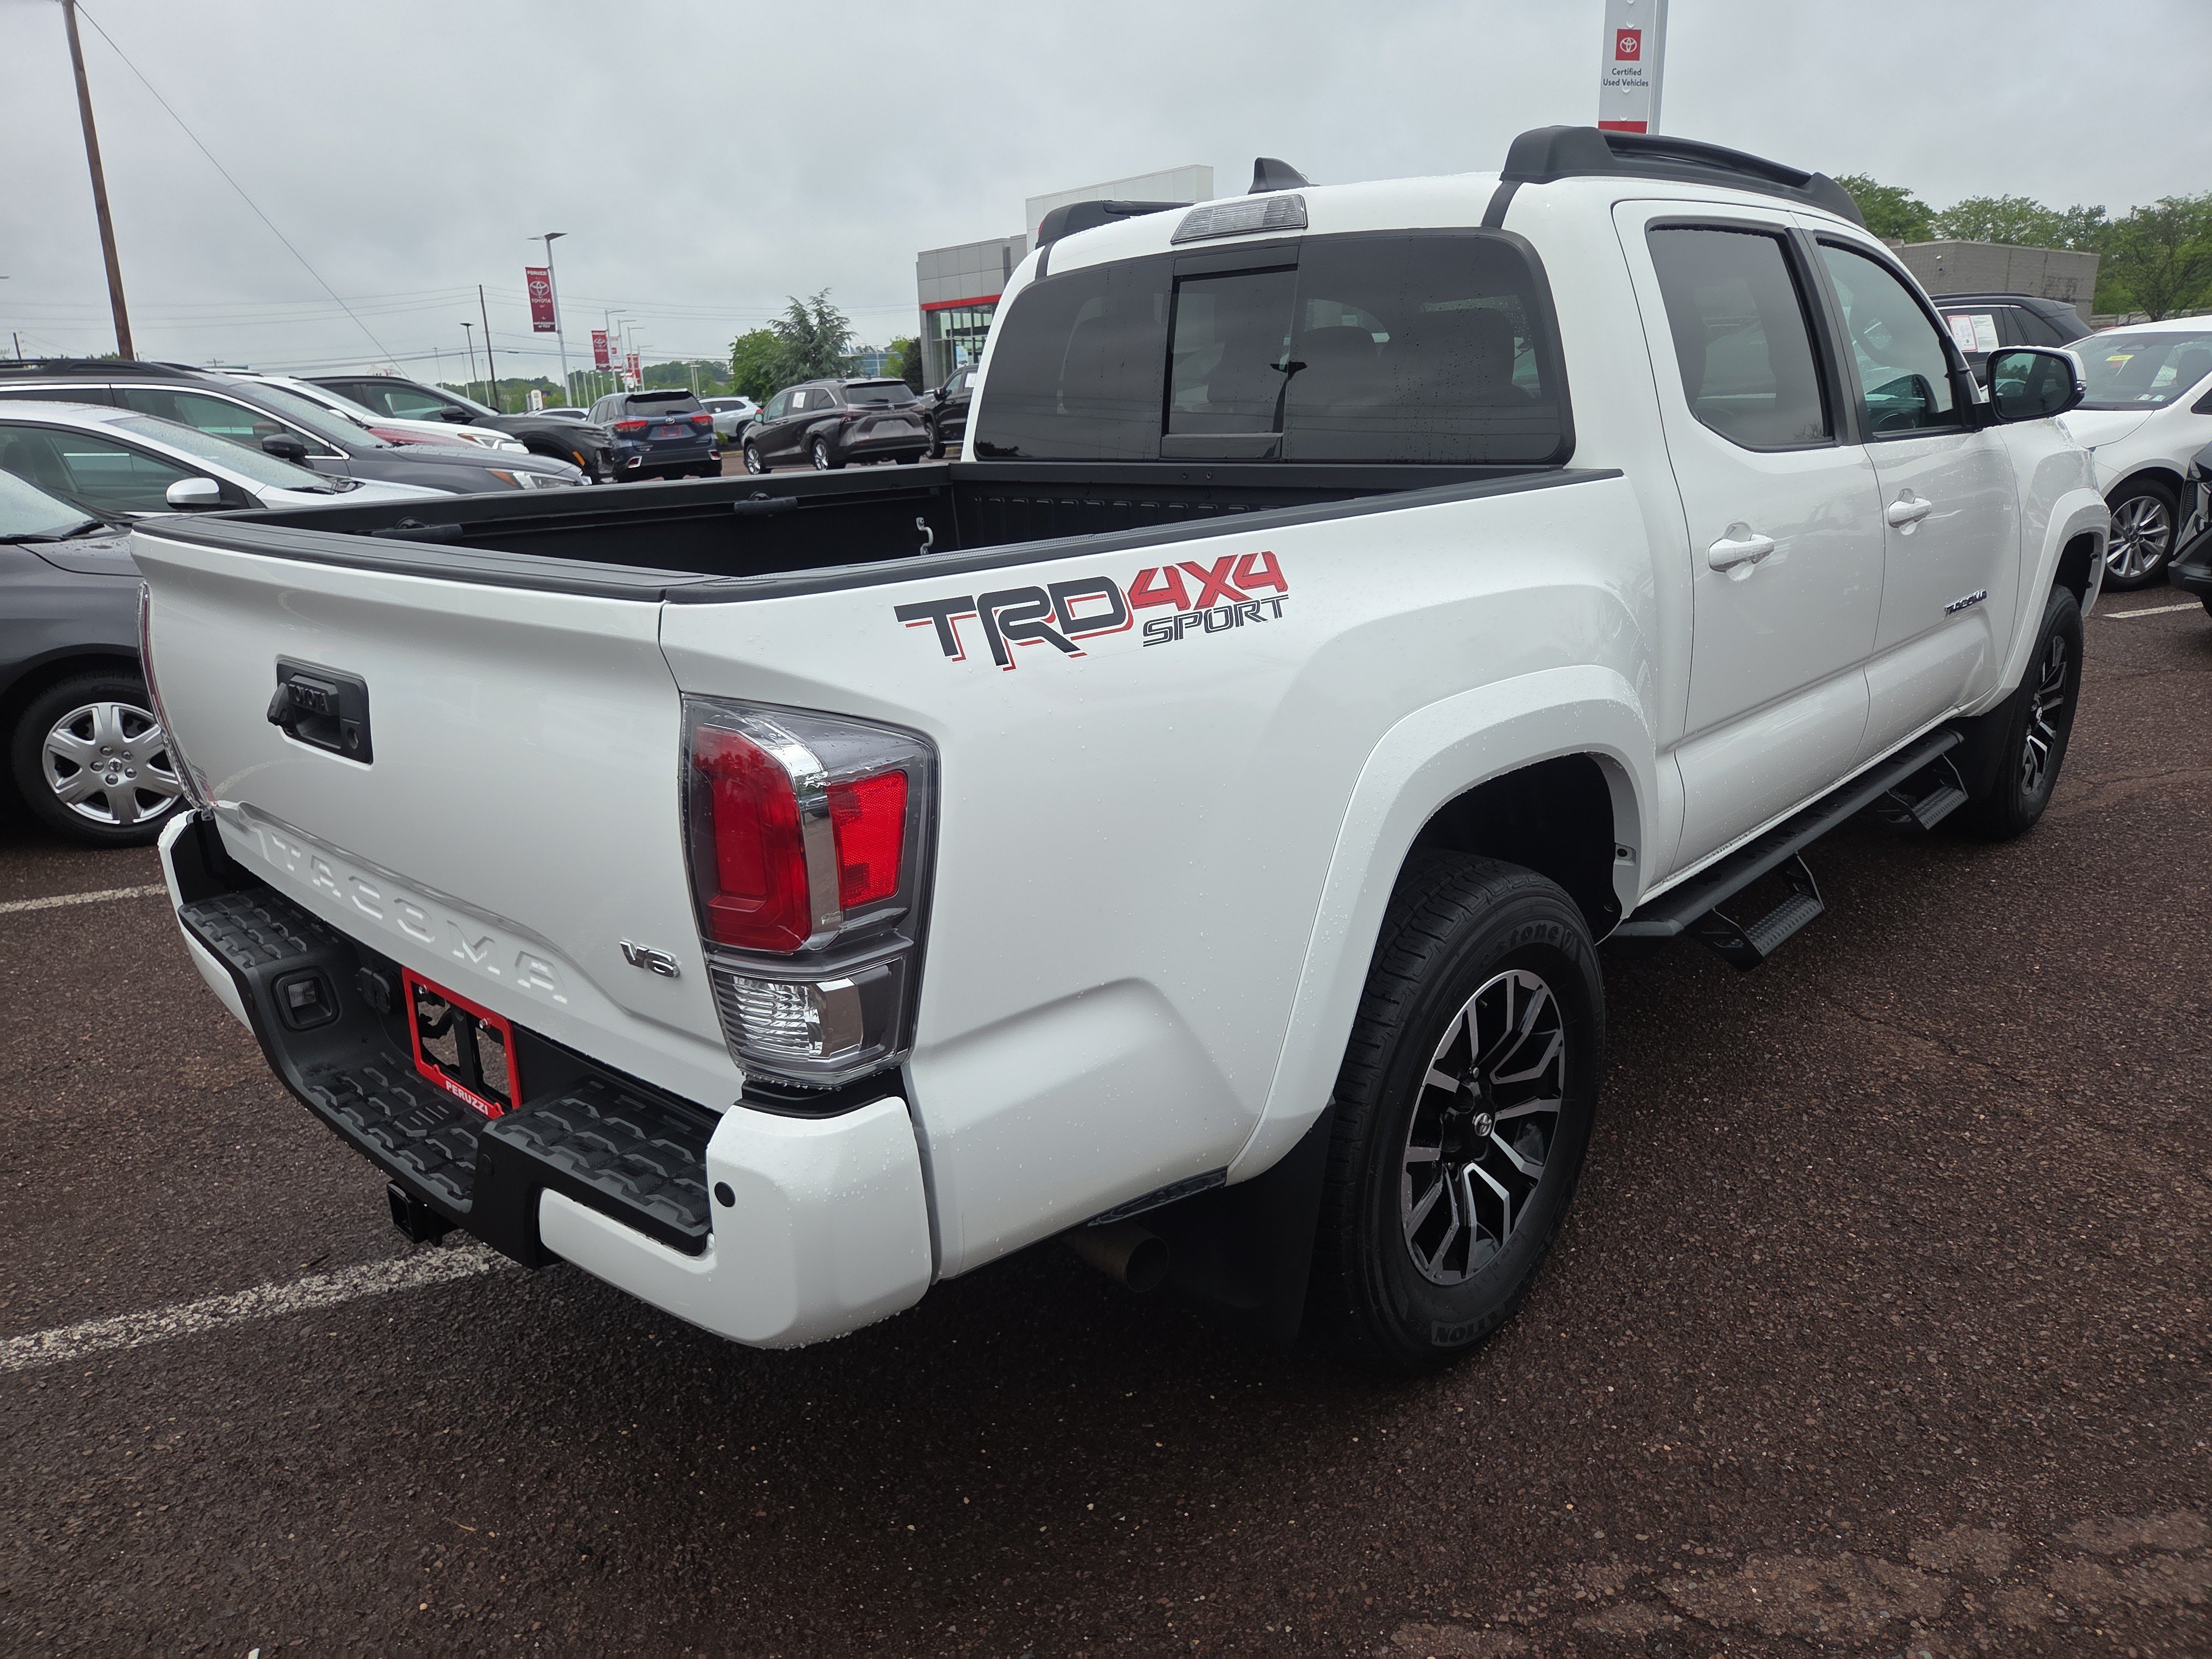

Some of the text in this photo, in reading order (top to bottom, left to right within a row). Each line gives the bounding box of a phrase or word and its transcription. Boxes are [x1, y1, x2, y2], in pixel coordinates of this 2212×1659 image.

[1612, 68, 1642, 76] Certified
[1622, 79, 1649, 87] Vehicles
[894, 551, 1289, 672] TRD 4X4
[1143, 595, 1289, 647] SPORT
[1944, 589, 1987, 617] TACOMA
[271, 832, 568, 1004] TACOMA
[620, 941, 680, 978] V6
[445, 1080, 488, 1115] PERUZZI
